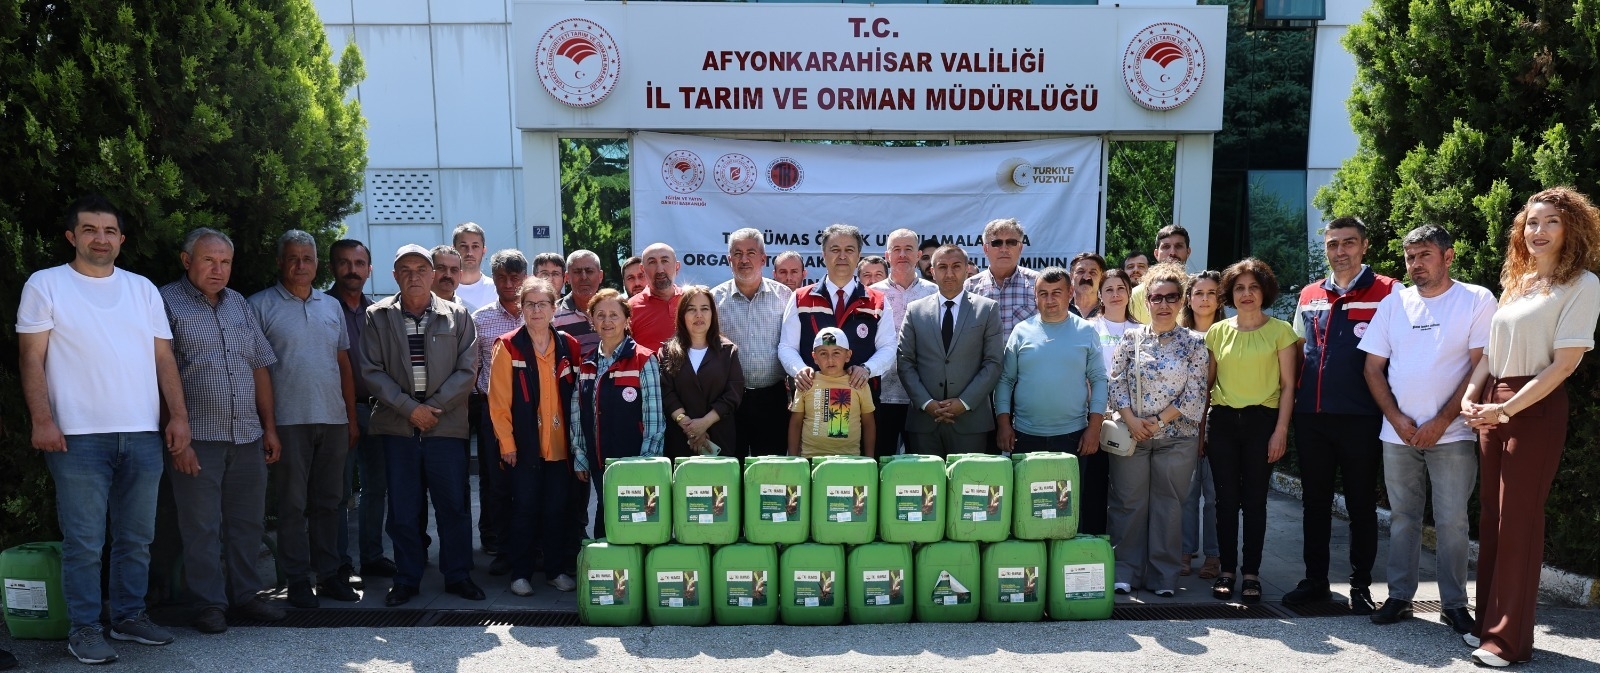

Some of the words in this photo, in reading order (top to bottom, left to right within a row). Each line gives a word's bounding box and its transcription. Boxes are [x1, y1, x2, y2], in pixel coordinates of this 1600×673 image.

[848, 17, 899, 38] T.C.
[702, 47, 932, 72] AFYONKARAHİSAR
[941, 47, 1045, 73] VALİLİĞİ
[646, 81, 671, 109] İL
[679, 87, 763, 110] TARIM
[773, 87, 807, 110] VE
[817, 87, 915, 111] ORMAN
[926, 83, 1099, 112] MÜDÜRLÜĞÜ
